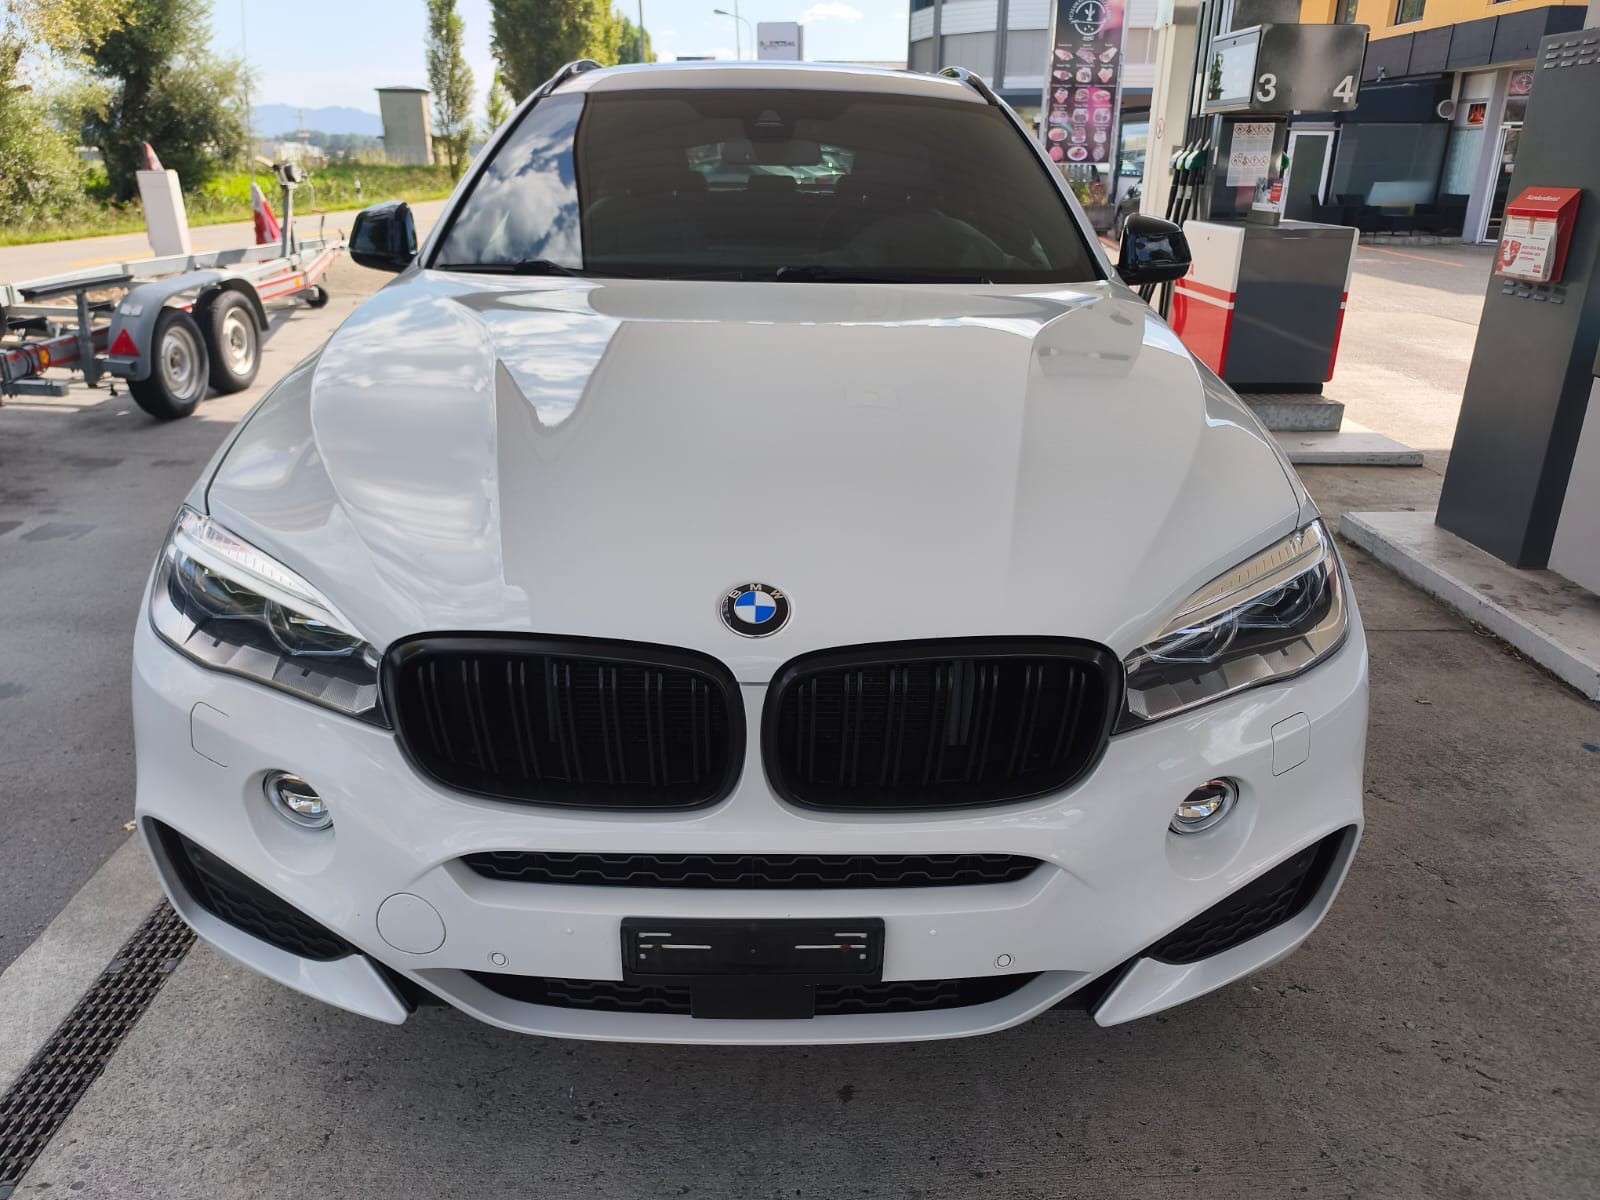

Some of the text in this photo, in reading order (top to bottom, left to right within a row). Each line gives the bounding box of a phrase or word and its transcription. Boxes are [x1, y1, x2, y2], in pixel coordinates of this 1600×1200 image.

[1256, 73, 1277, 102] 3
[1332, 75, 1354, 103] 4
[729, 583, 784, 599] BMW
